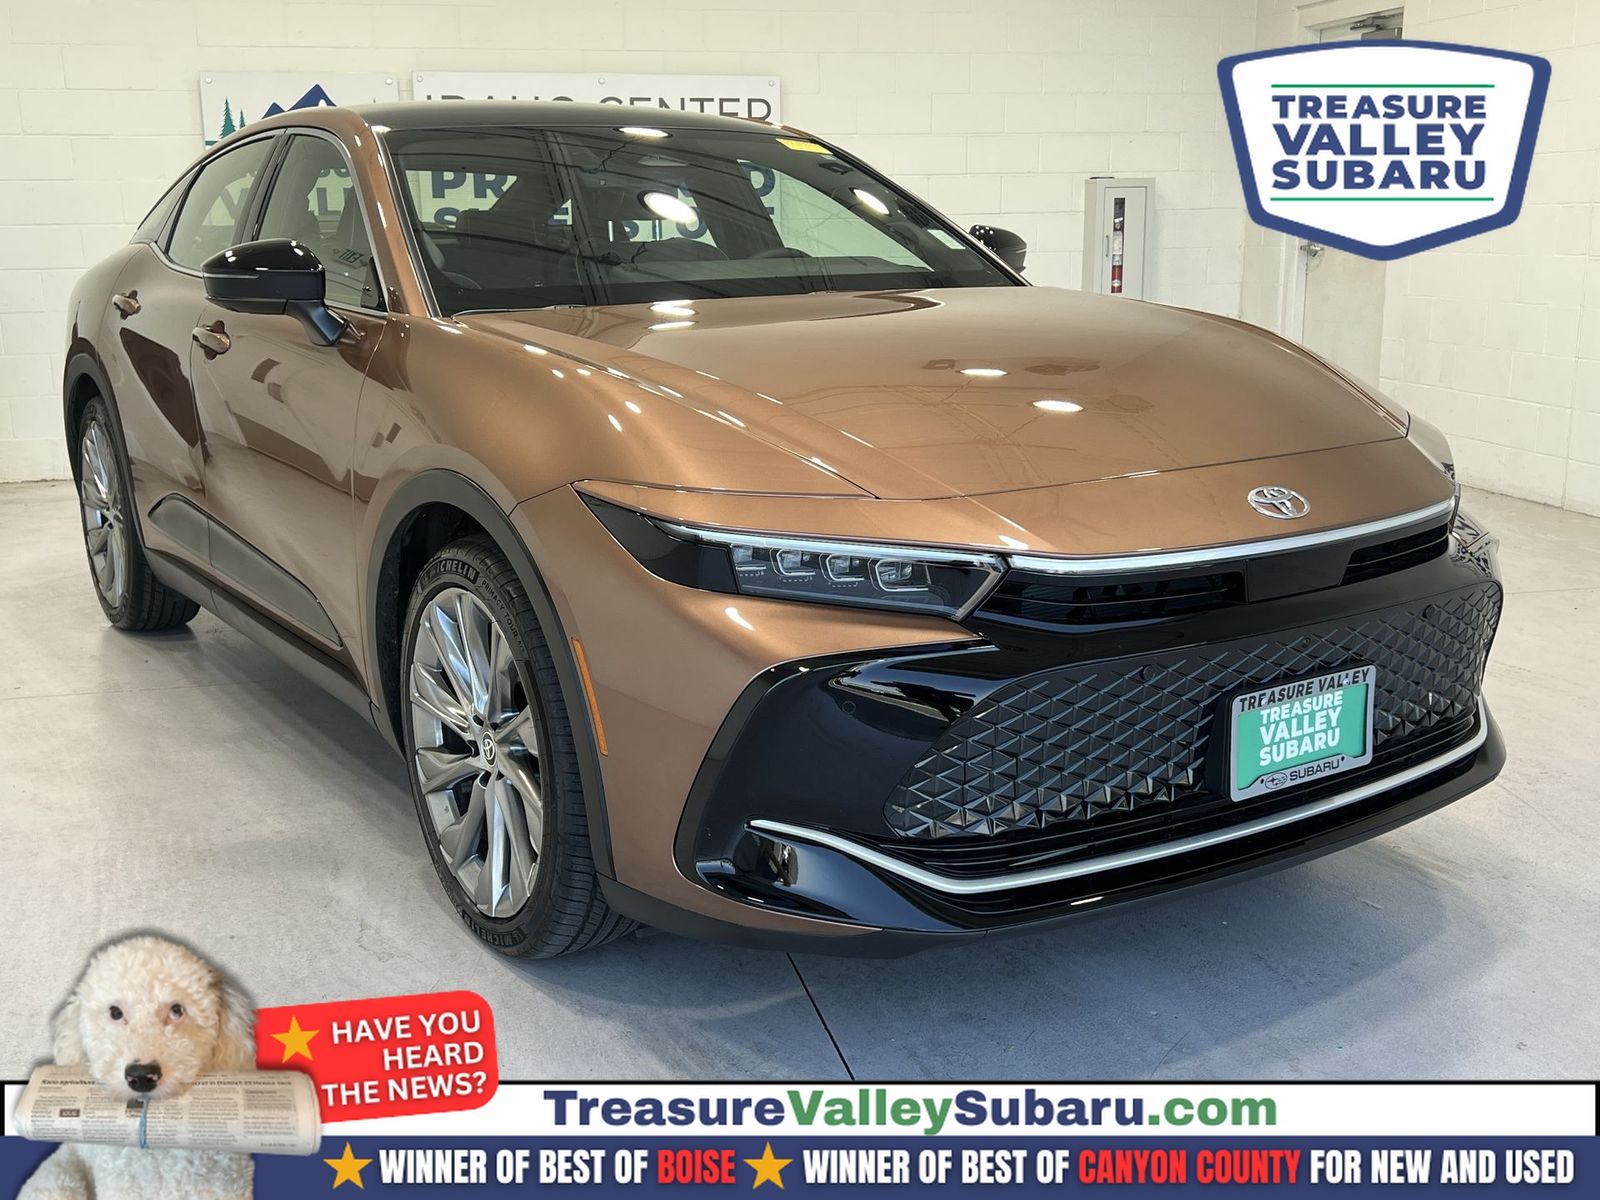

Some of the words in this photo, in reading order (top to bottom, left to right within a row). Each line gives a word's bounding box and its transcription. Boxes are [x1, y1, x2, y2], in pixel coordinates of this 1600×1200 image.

[481, 579, 505, 610] PRIMACY
[504, 612, 519, 639] TOUR
[1239, 681, 1315, 712] TREASURE
[1318, 668, 1370, 693] VALLEY
[1289, 758, 1340, 782] SUBARU
